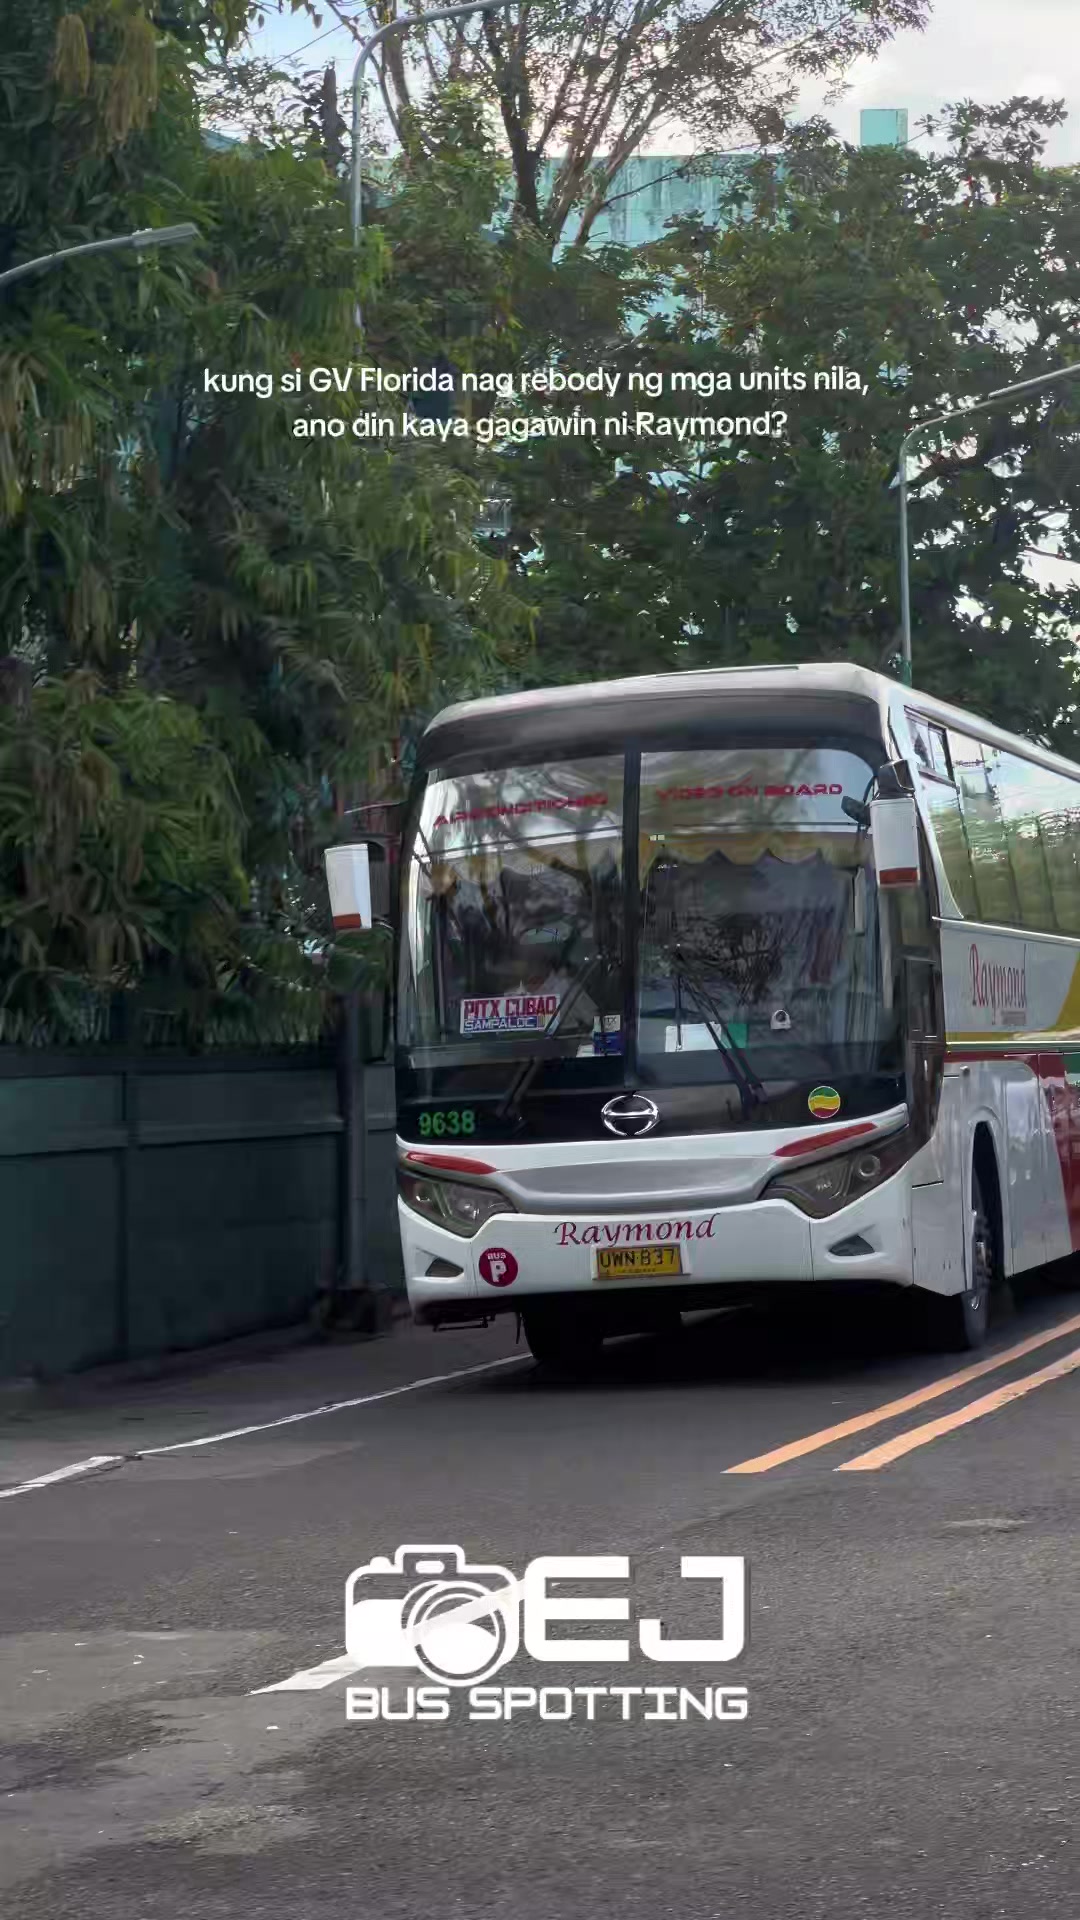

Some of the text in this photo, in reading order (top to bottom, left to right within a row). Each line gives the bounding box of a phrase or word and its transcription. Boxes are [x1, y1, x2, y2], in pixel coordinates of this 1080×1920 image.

[968, 943, 1027, 1026] Raymond
[463, 995, 558, 1019] PITX CUBAO
[463, 1015, 538, 1032] SAMPALOC
[418, 1109, 477, 1138] 9638
[552, 1212, 722, 1248] Raymond
[486, 1251, 507, 1261] BUS
